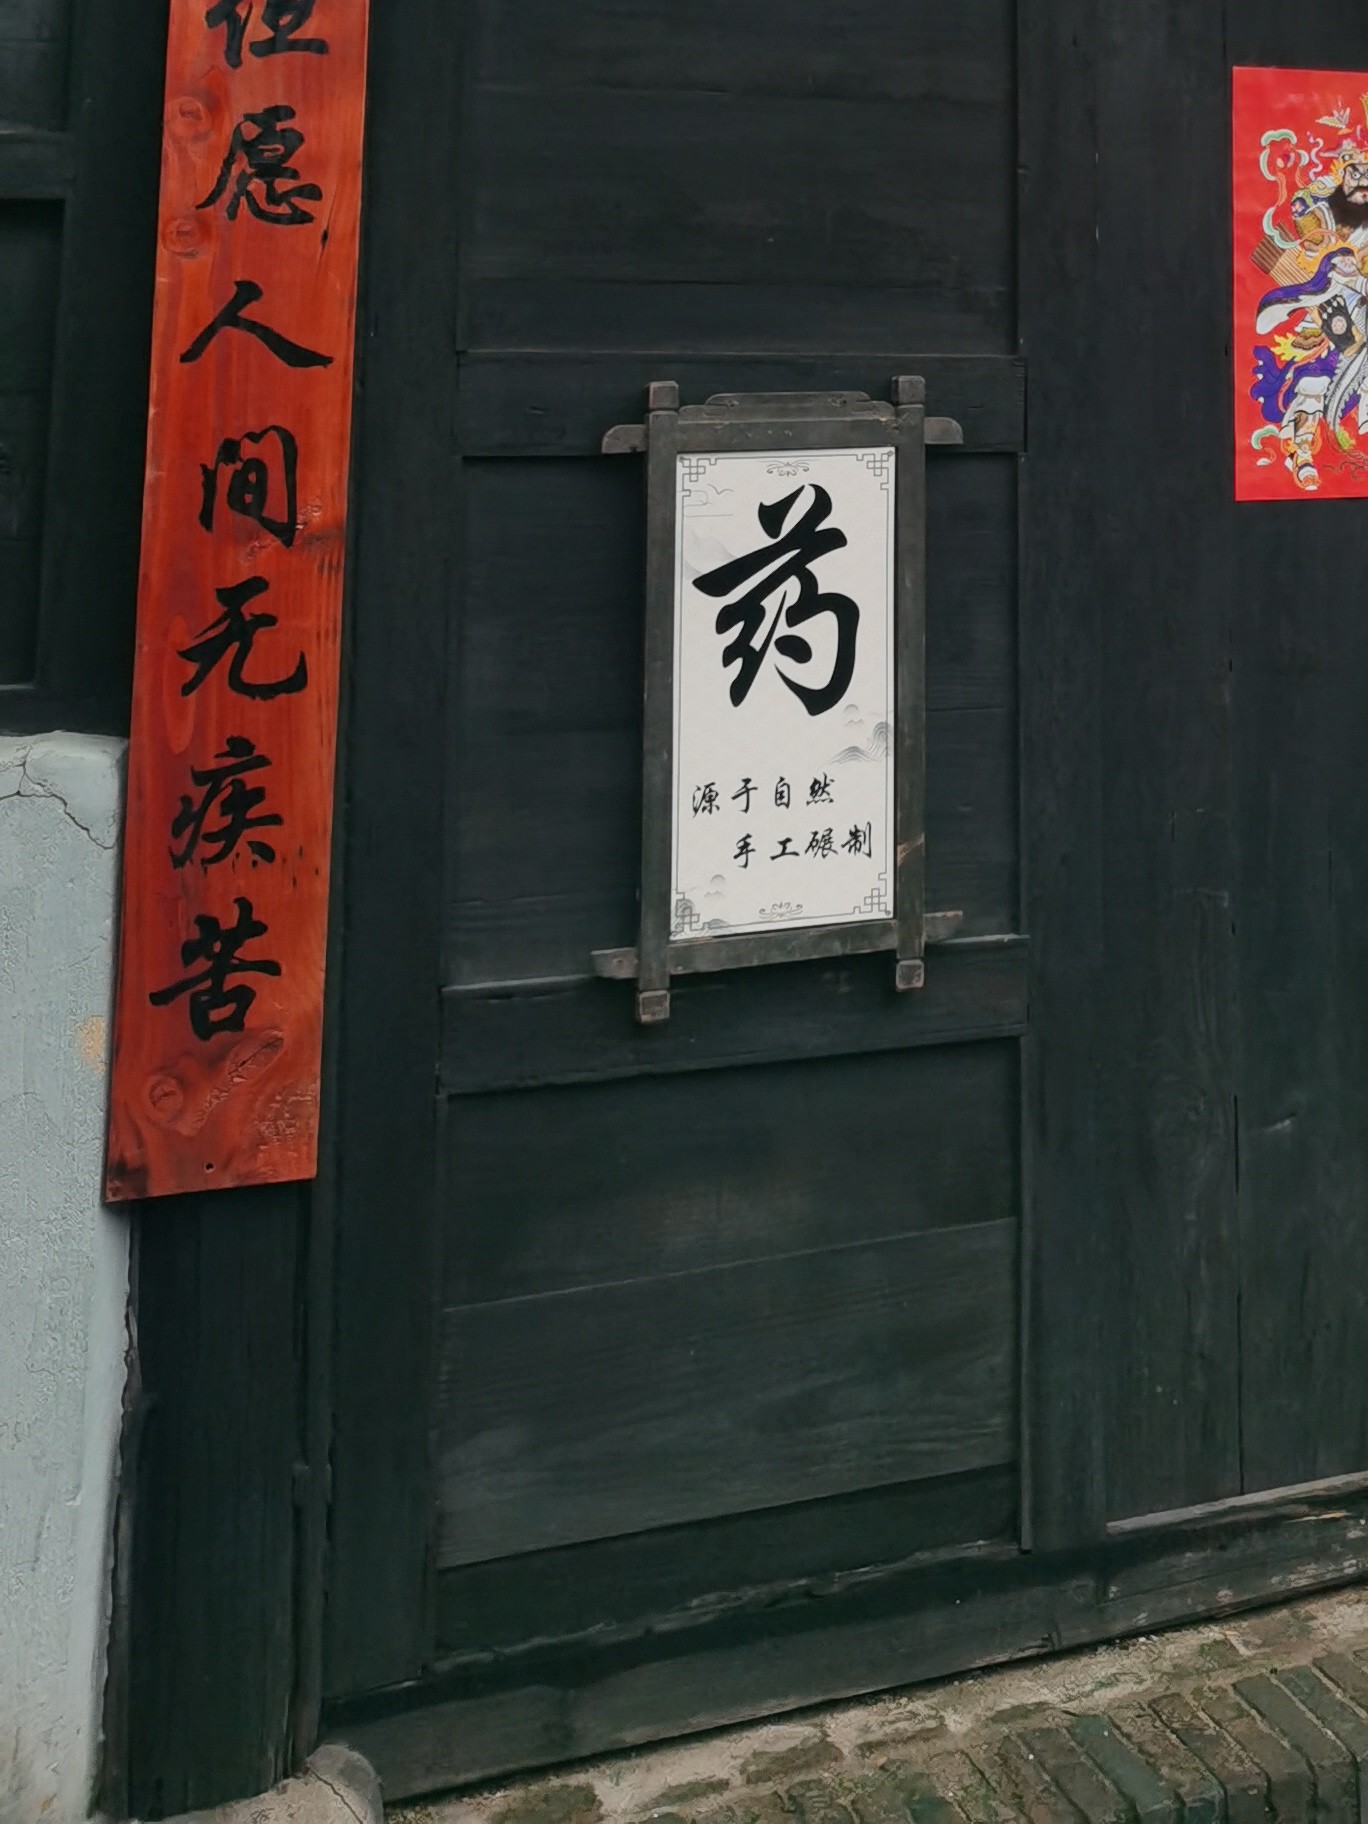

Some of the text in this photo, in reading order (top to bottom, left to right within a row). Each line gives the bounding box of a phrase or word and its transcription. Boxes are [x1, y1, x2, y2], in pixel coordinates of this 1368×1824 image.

[692, 483, 861, 717] 药
[692, 773, 835, 818] 源于自然
[733, 821, 873, 869] 手工碾制
